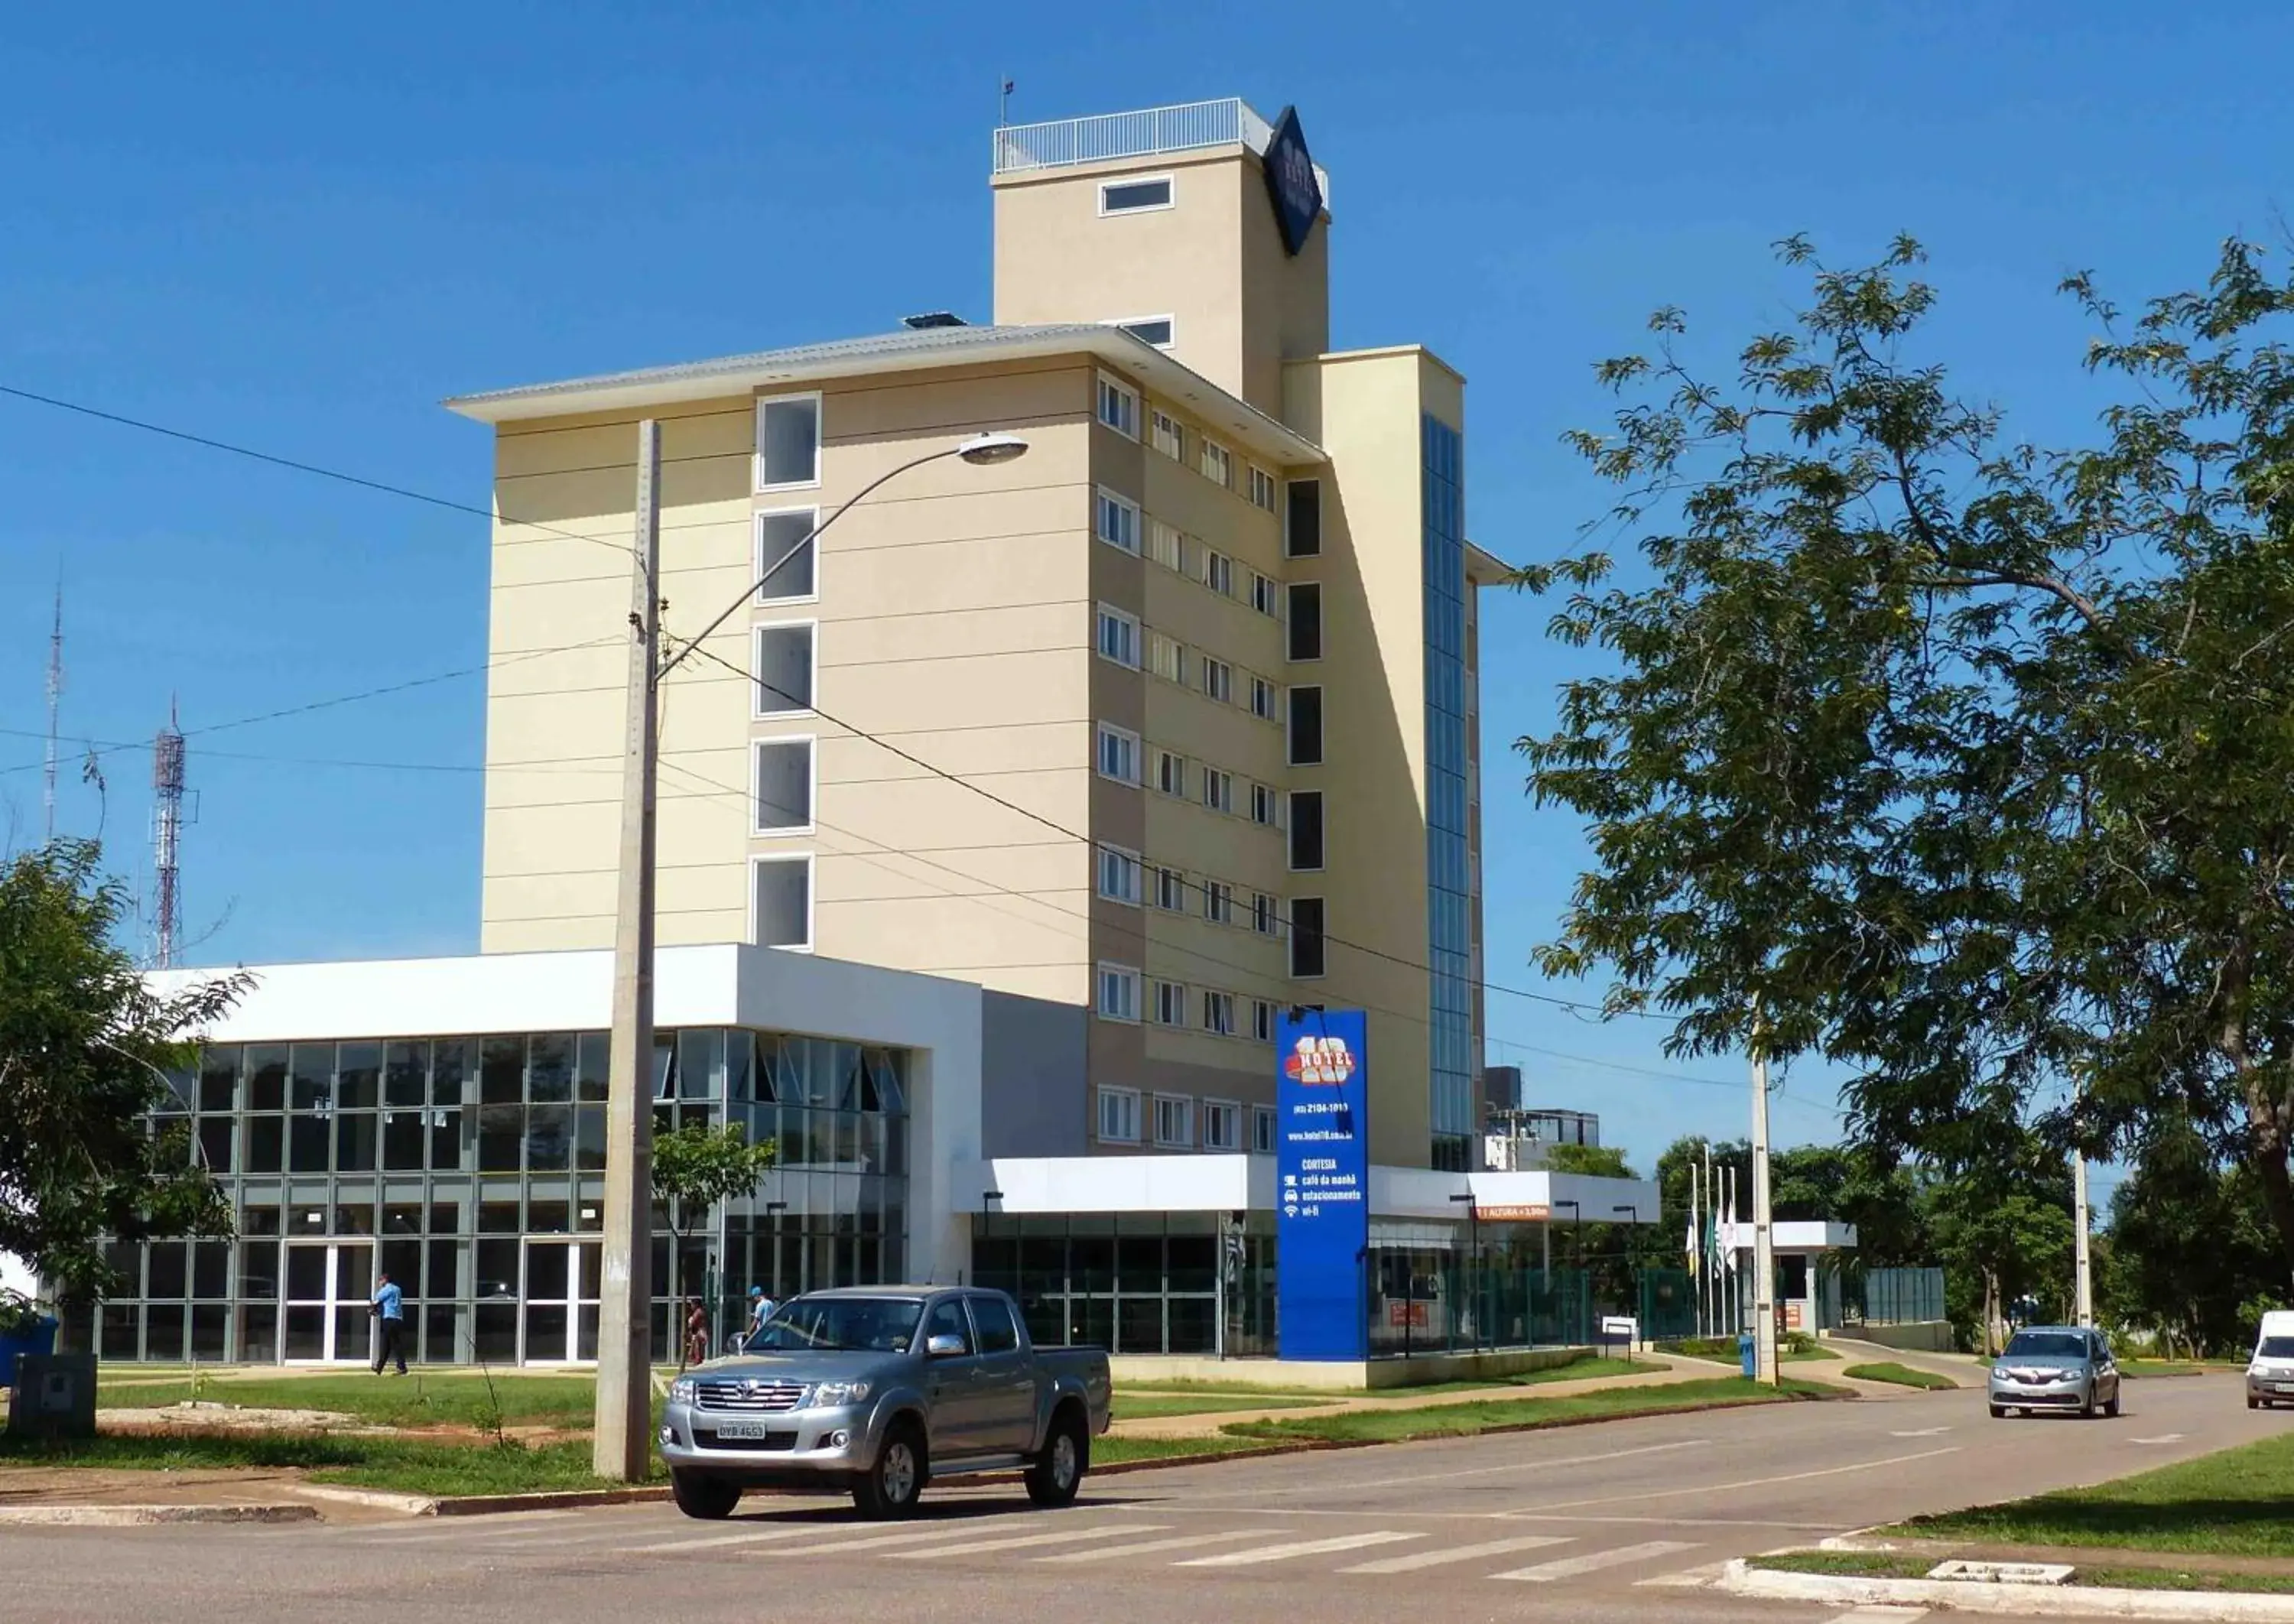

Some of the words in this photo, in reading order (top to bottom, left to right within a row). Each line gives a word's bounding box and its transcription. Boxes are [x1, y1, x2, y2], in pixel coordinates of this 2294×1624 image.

[1300, 1052, 1352, 1067] HOTEL
[1302, 1158, 1337, 1170] CORTESIA
[1302, 1176, 1319, 1186] café
[1321, 1174, 1330, 1184] da
[1331, 1174, 1356, 1184] manhã
[1302, 1190, 1361, 1201] estacionamento
